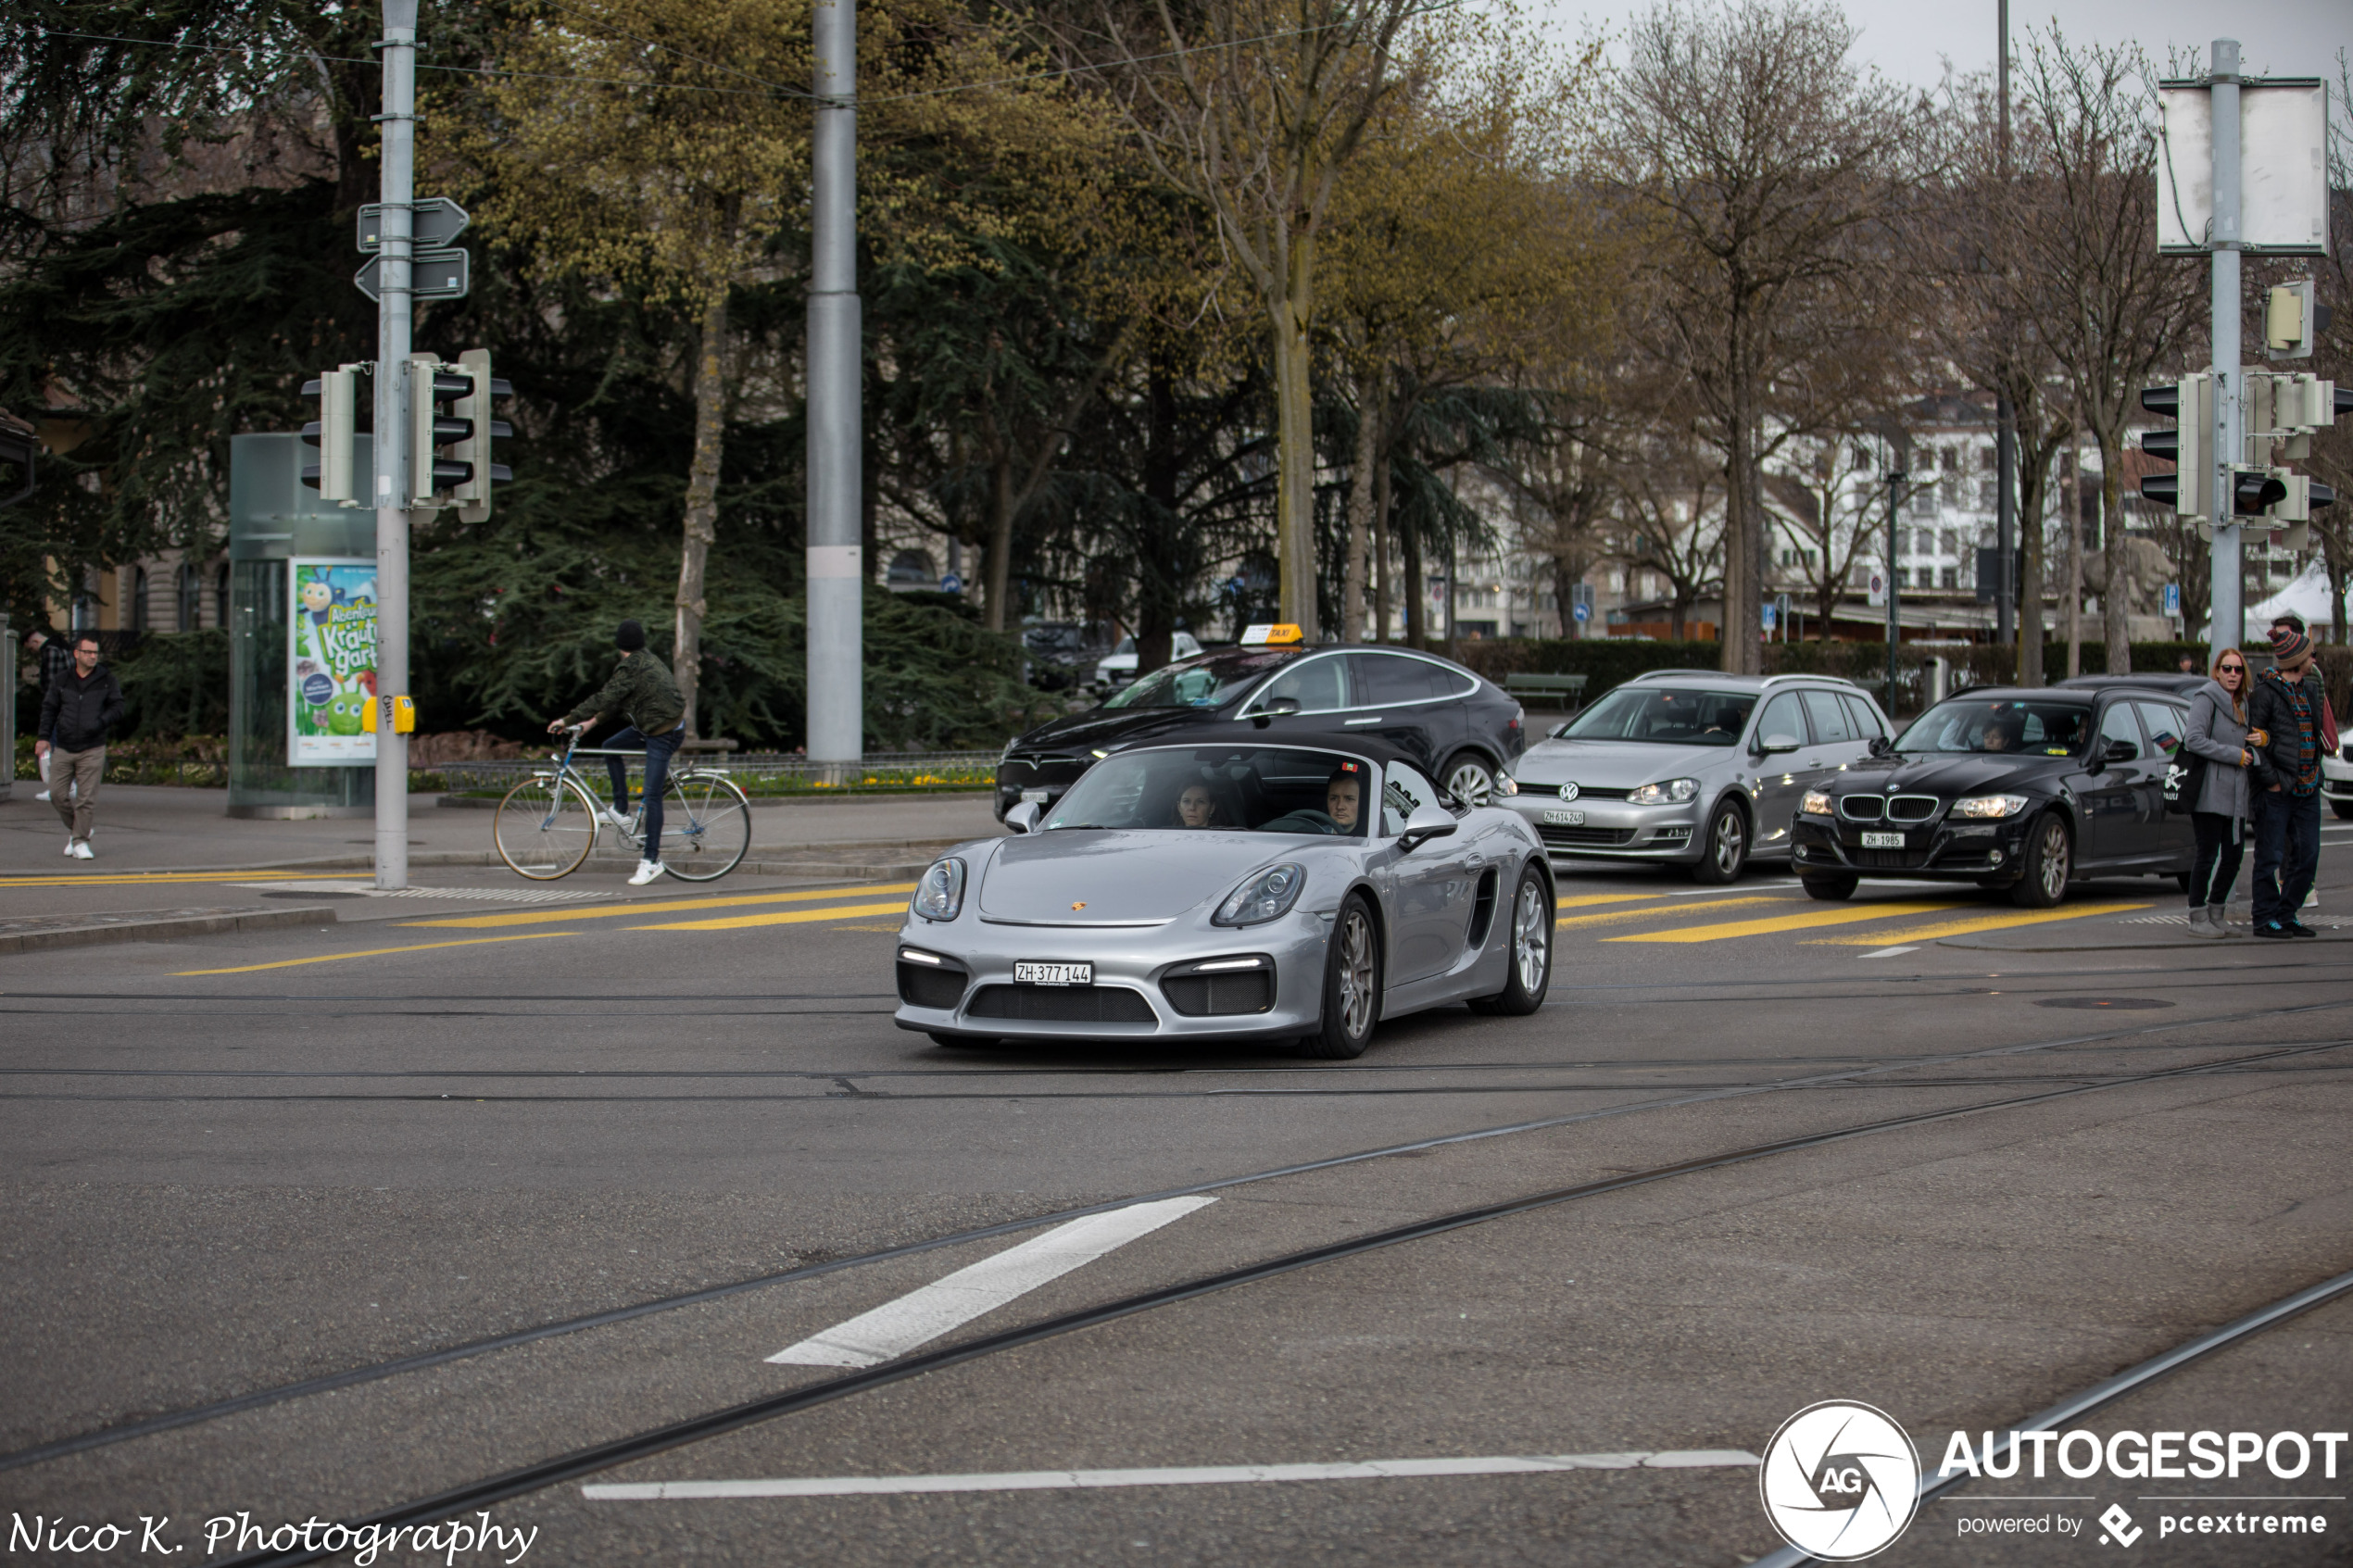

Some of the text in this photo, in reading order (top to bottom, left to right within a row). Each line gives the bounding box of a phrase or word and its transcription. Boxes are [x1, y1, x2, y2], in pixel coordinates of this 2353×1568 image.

[332, 603, 377, 623] Abenteu
[1270, 629, 1290, 637] TAXI
[334, 645, 377, 676] gart
[1569, 813, 1583, 822] 240
[1064, 966, 1088, 982] 144
